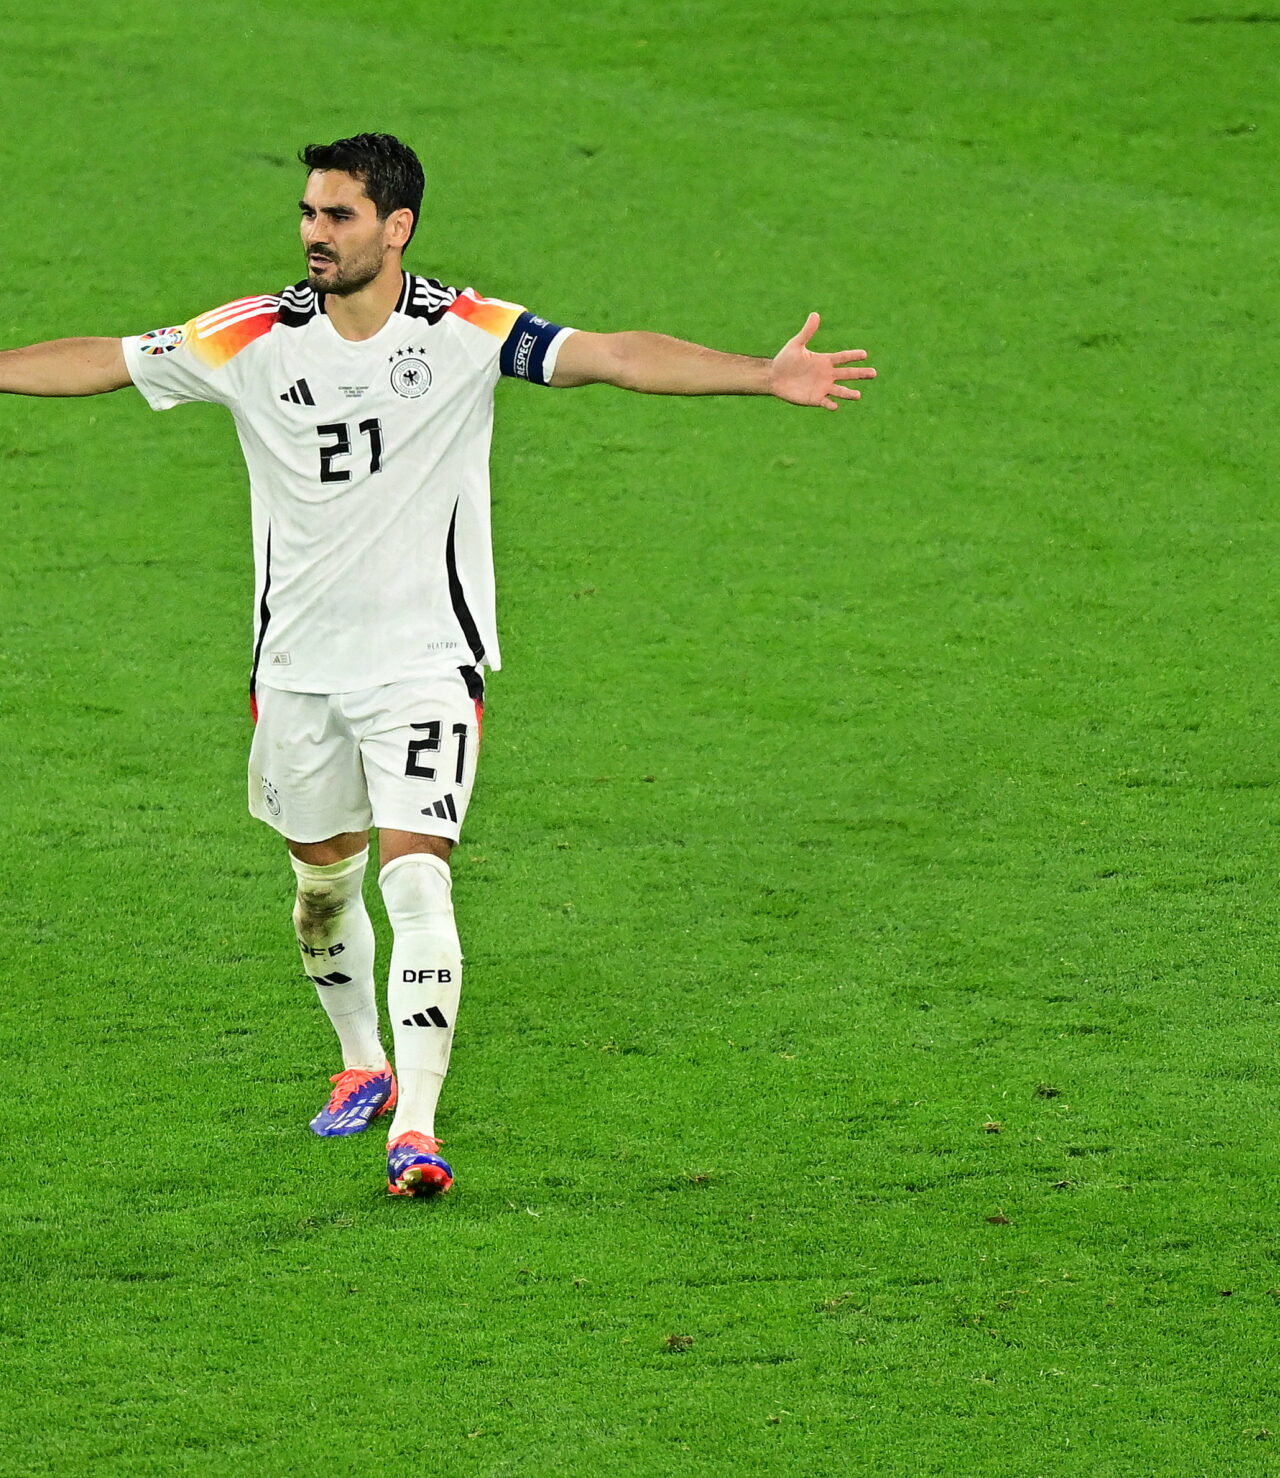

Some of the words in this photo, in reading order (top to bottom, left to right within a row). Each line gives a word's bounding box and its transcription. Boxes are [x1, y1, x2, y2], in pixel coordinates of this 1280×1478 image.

[516, 332, 534, 376] RESPECT
[316, 417, 385, 485] 21
[404, 720, 468, 787] 21
[298, 939, 346, 958] DFB
[402, 969, 452, 984] DFB
